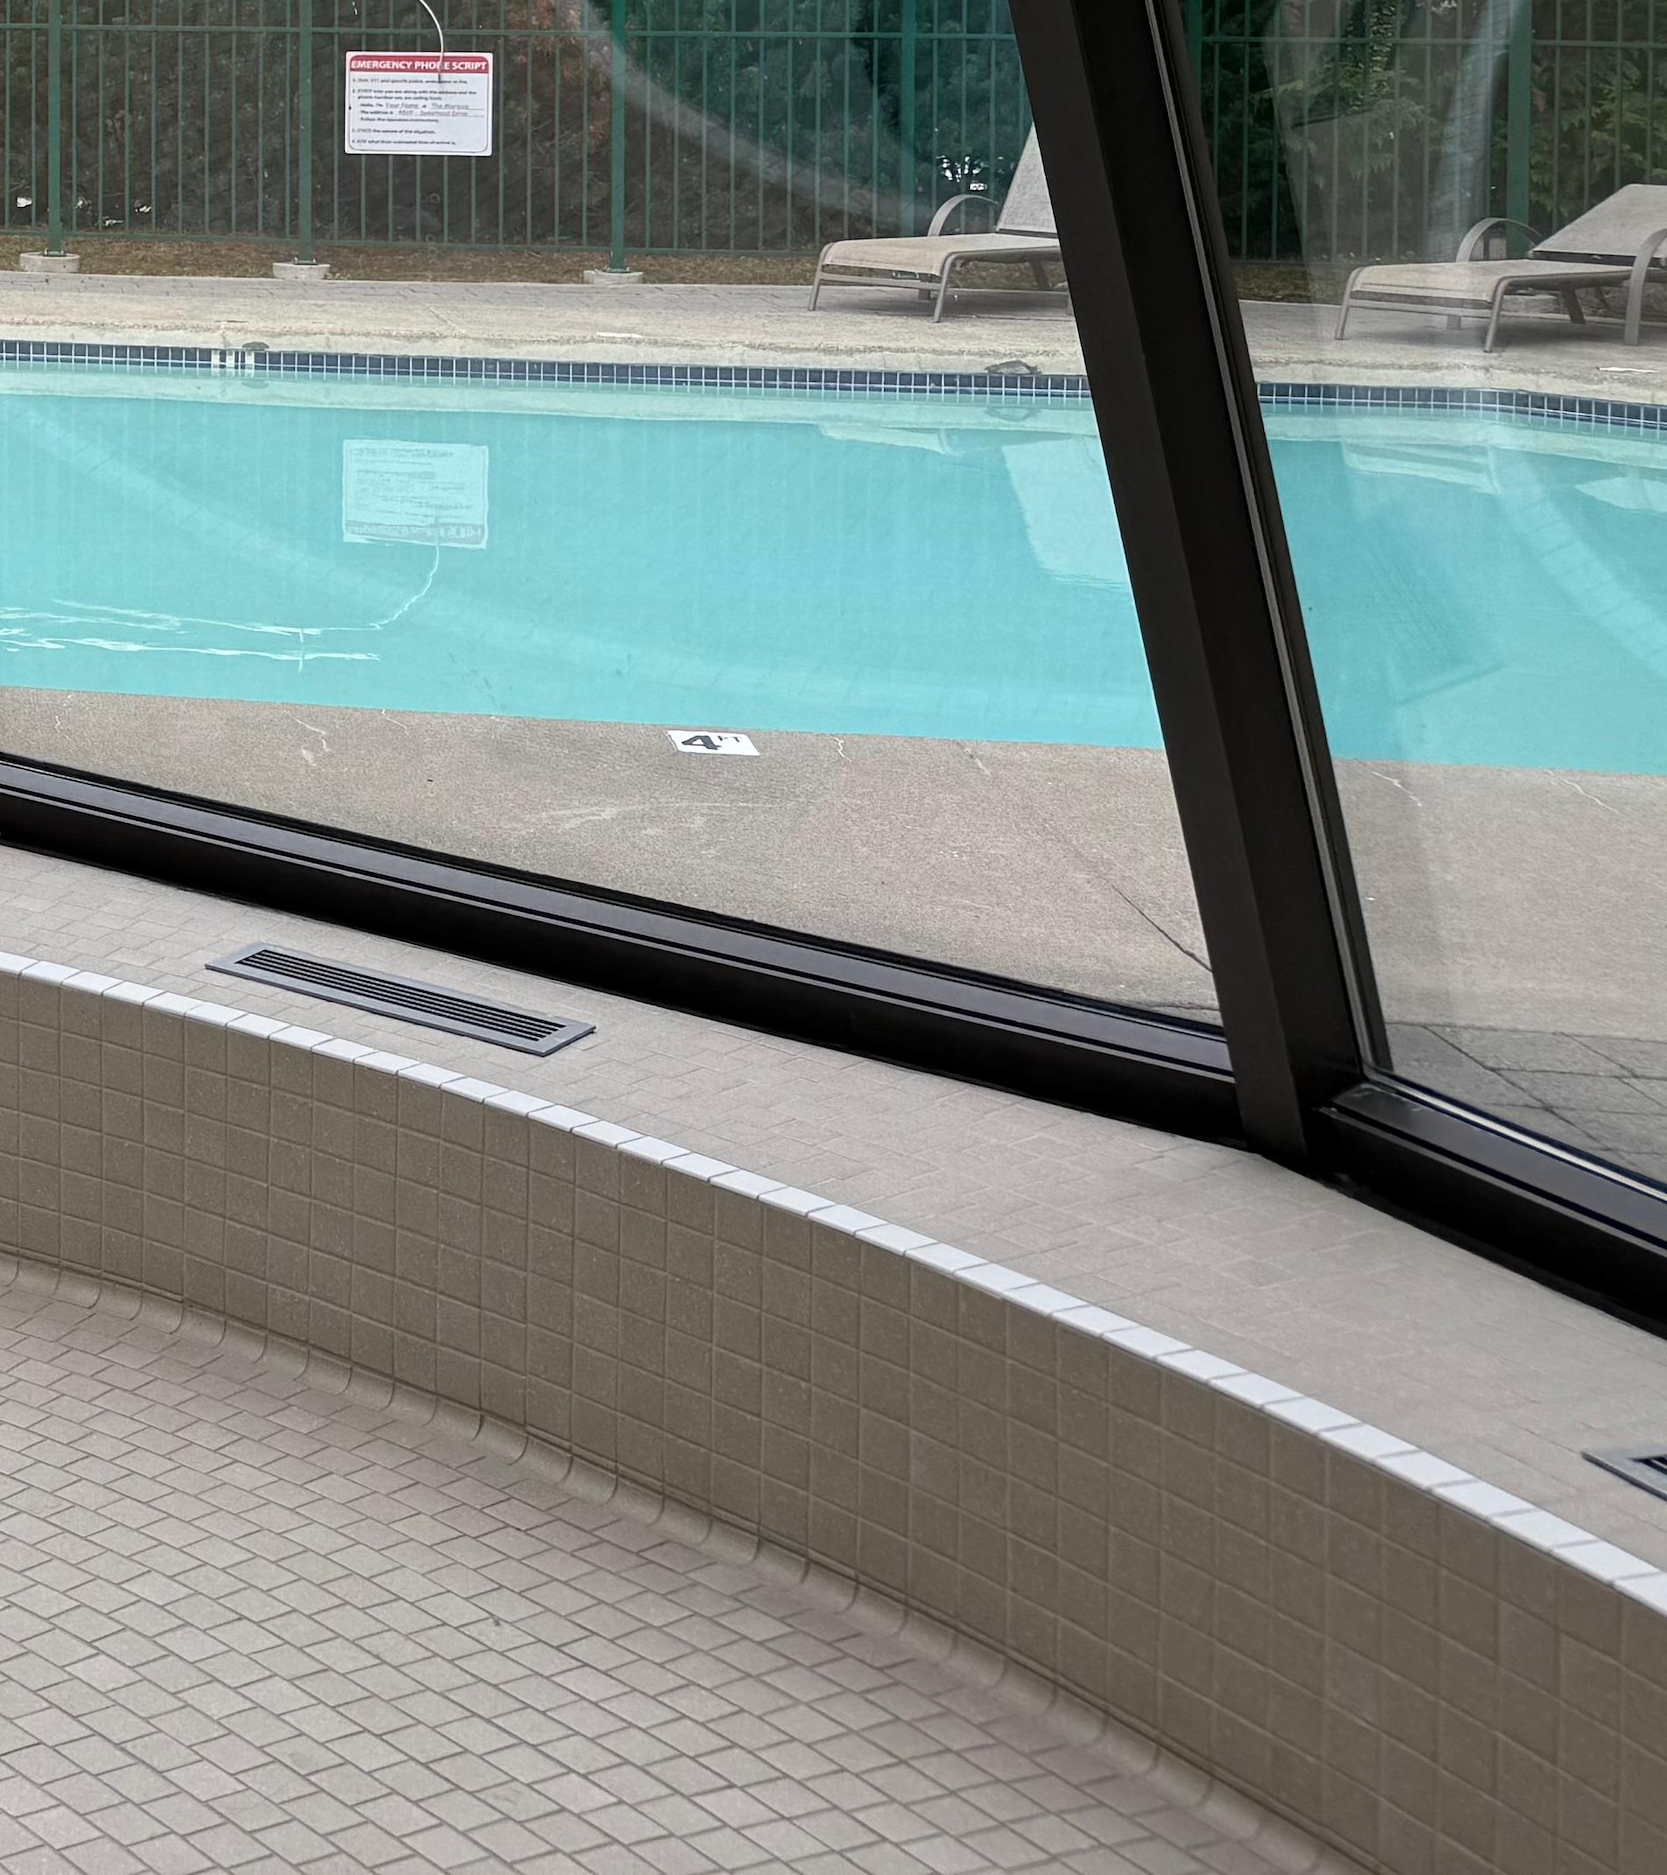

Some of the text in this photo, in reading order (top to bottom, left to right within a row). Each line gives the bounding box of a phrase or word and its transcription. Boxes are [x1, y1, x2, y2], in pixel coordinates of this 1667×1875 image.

[351, 60, 487, 71] EMERGENCY PHOE SCRIPT
[681, 735, 722, 750] 4
